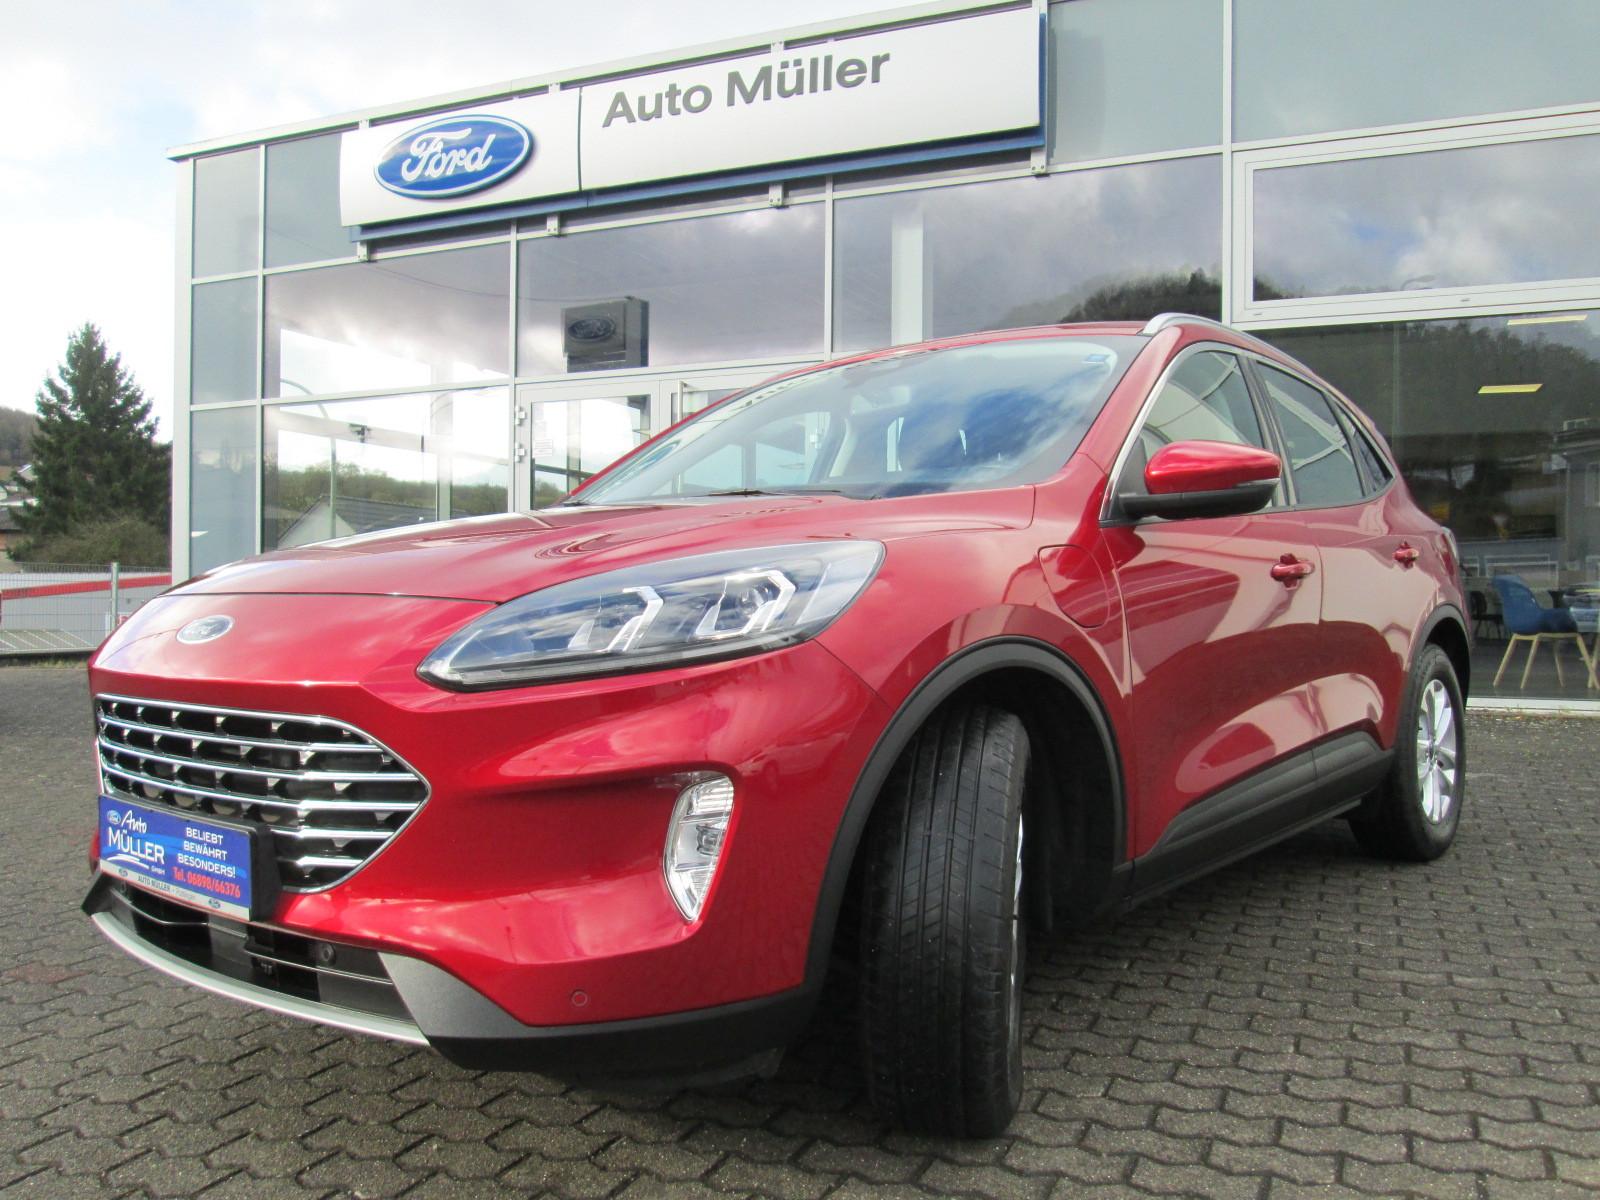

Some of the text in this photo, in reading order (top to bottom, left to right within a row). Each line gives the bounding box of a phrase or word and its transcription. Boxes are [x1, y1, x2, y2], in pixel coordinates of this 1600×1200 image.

[602, 53, 891, 128] Auto Müller
[400, 127, 497, 181] Ford
[121, 810, 148, 833] Auto
[108, 827, 165, 865] MÜLLER
[185, 827, 224, 845] BELIEBT
[183, 840, 228, 861] BEWÄHRT
[172, 867, 186, 882] Tel.
[177, 853, 236, 878] BESONDERS!
